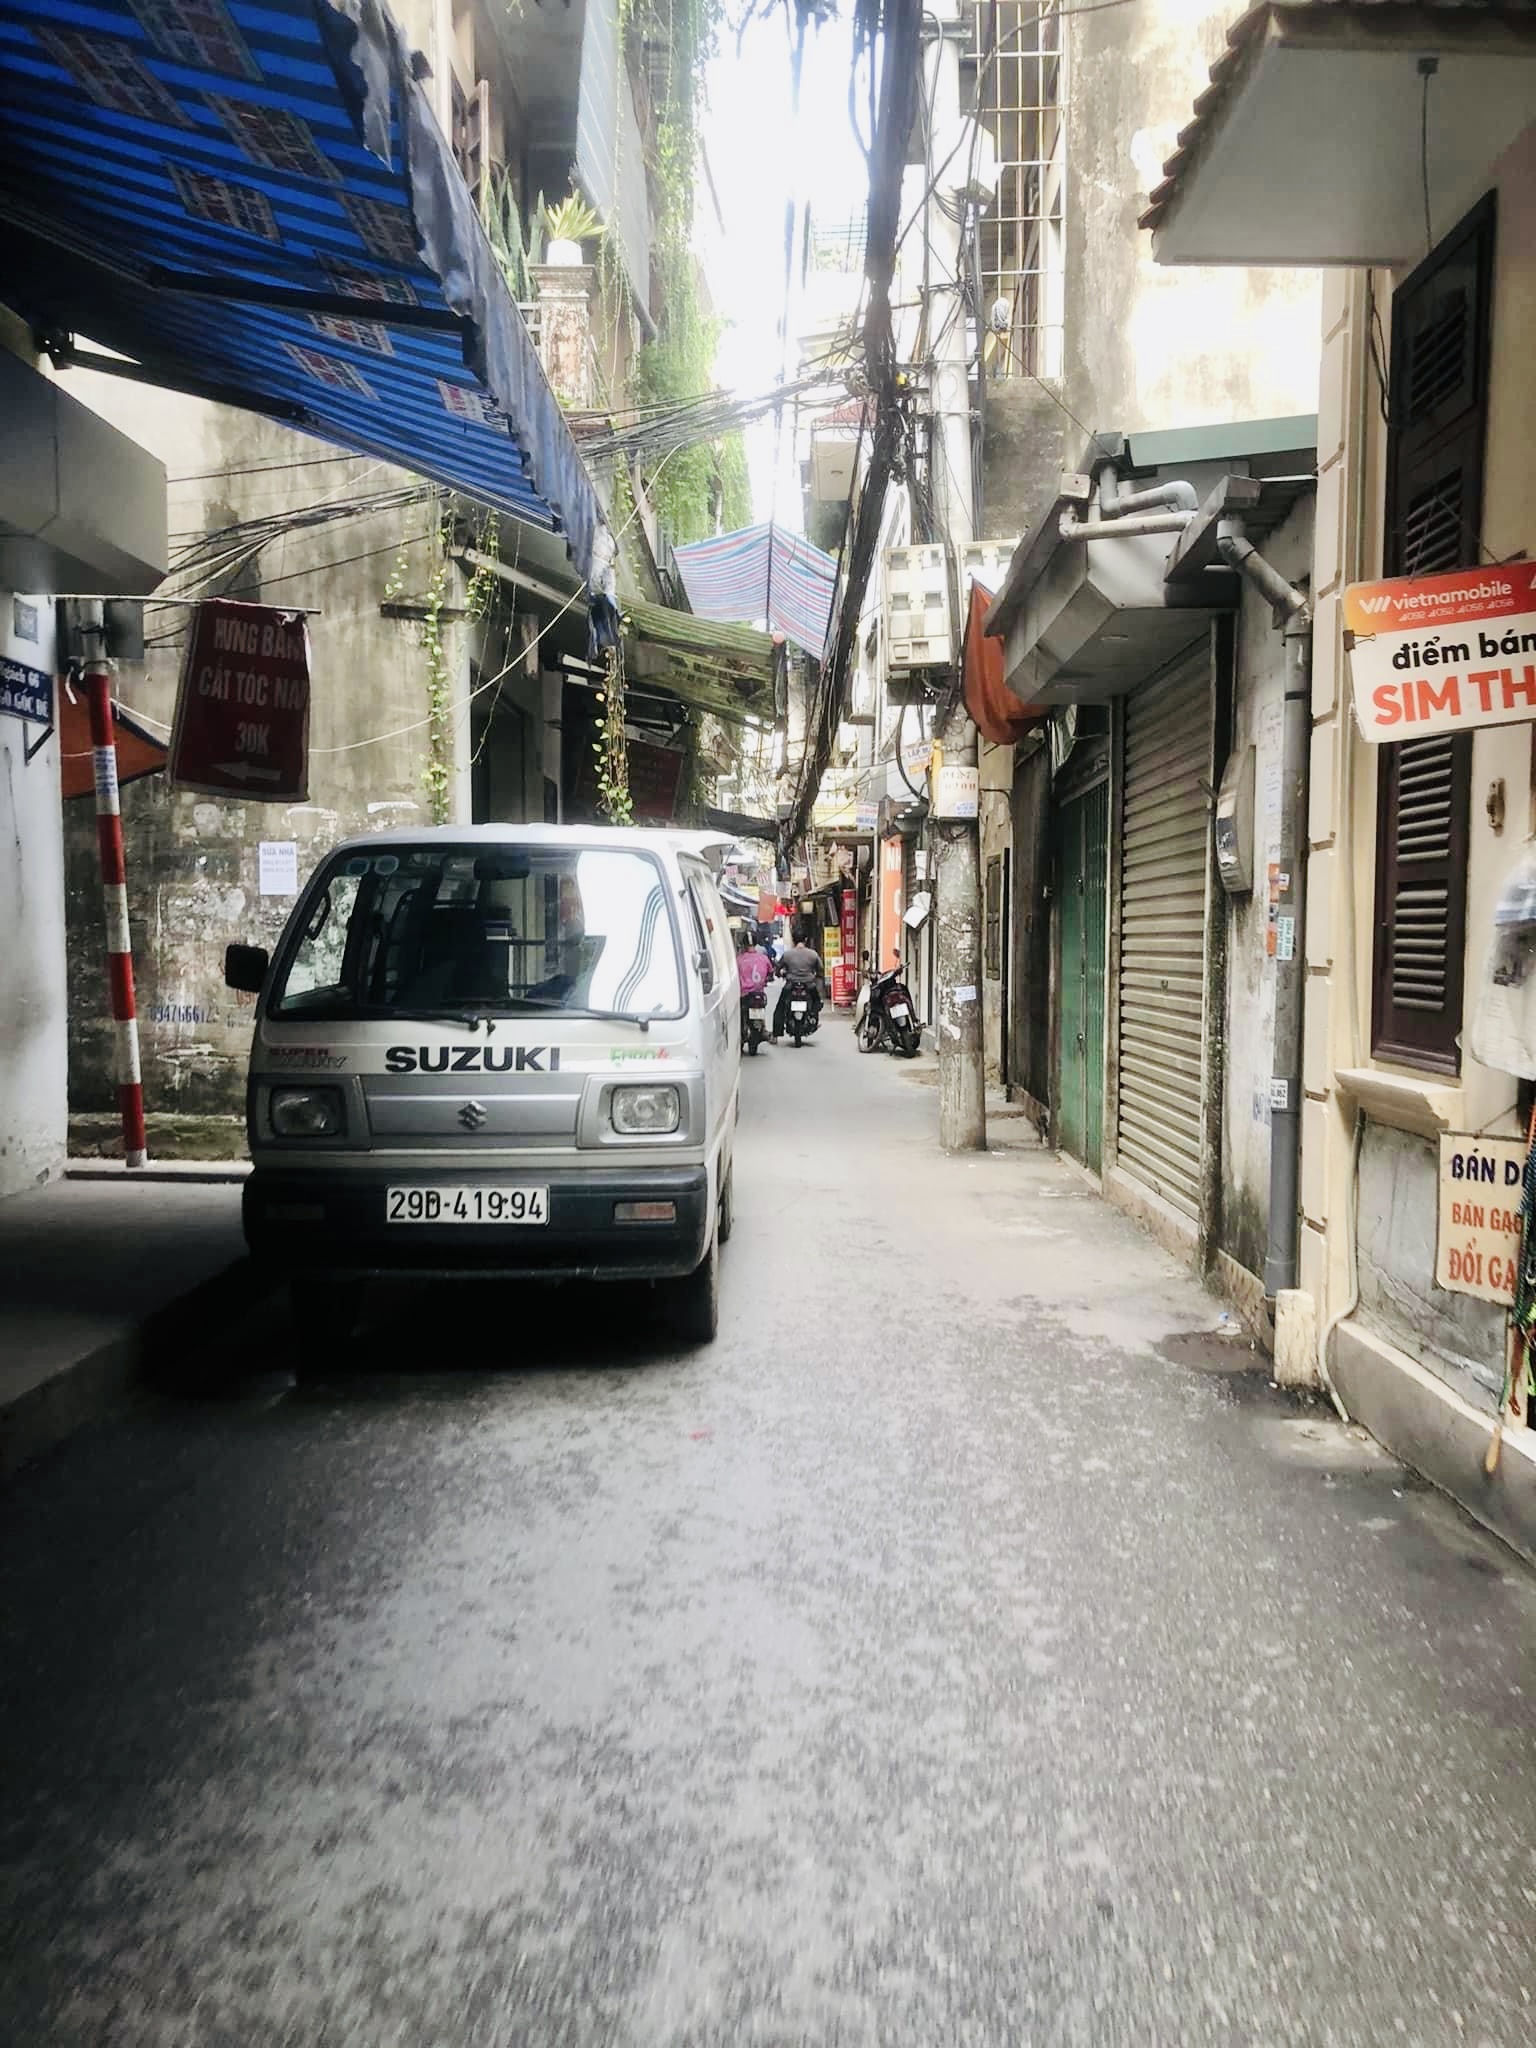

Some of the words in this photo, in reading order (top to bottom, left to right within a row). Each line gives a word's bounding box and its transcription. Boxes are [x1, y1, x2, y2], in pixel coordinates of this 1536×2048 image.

[1393, 581, 1513, 611] vietnamobile
[1392, 636, 1470, 670] điểm
[1478, 629, 1536, 658] bán
[1372, 676, 1461, 726] SIM
[751, 964, 761, 983] 6
[386, 1047, 560, 1073] SUZUKI
[1451, 1148, 1496, 1184] BÁN
